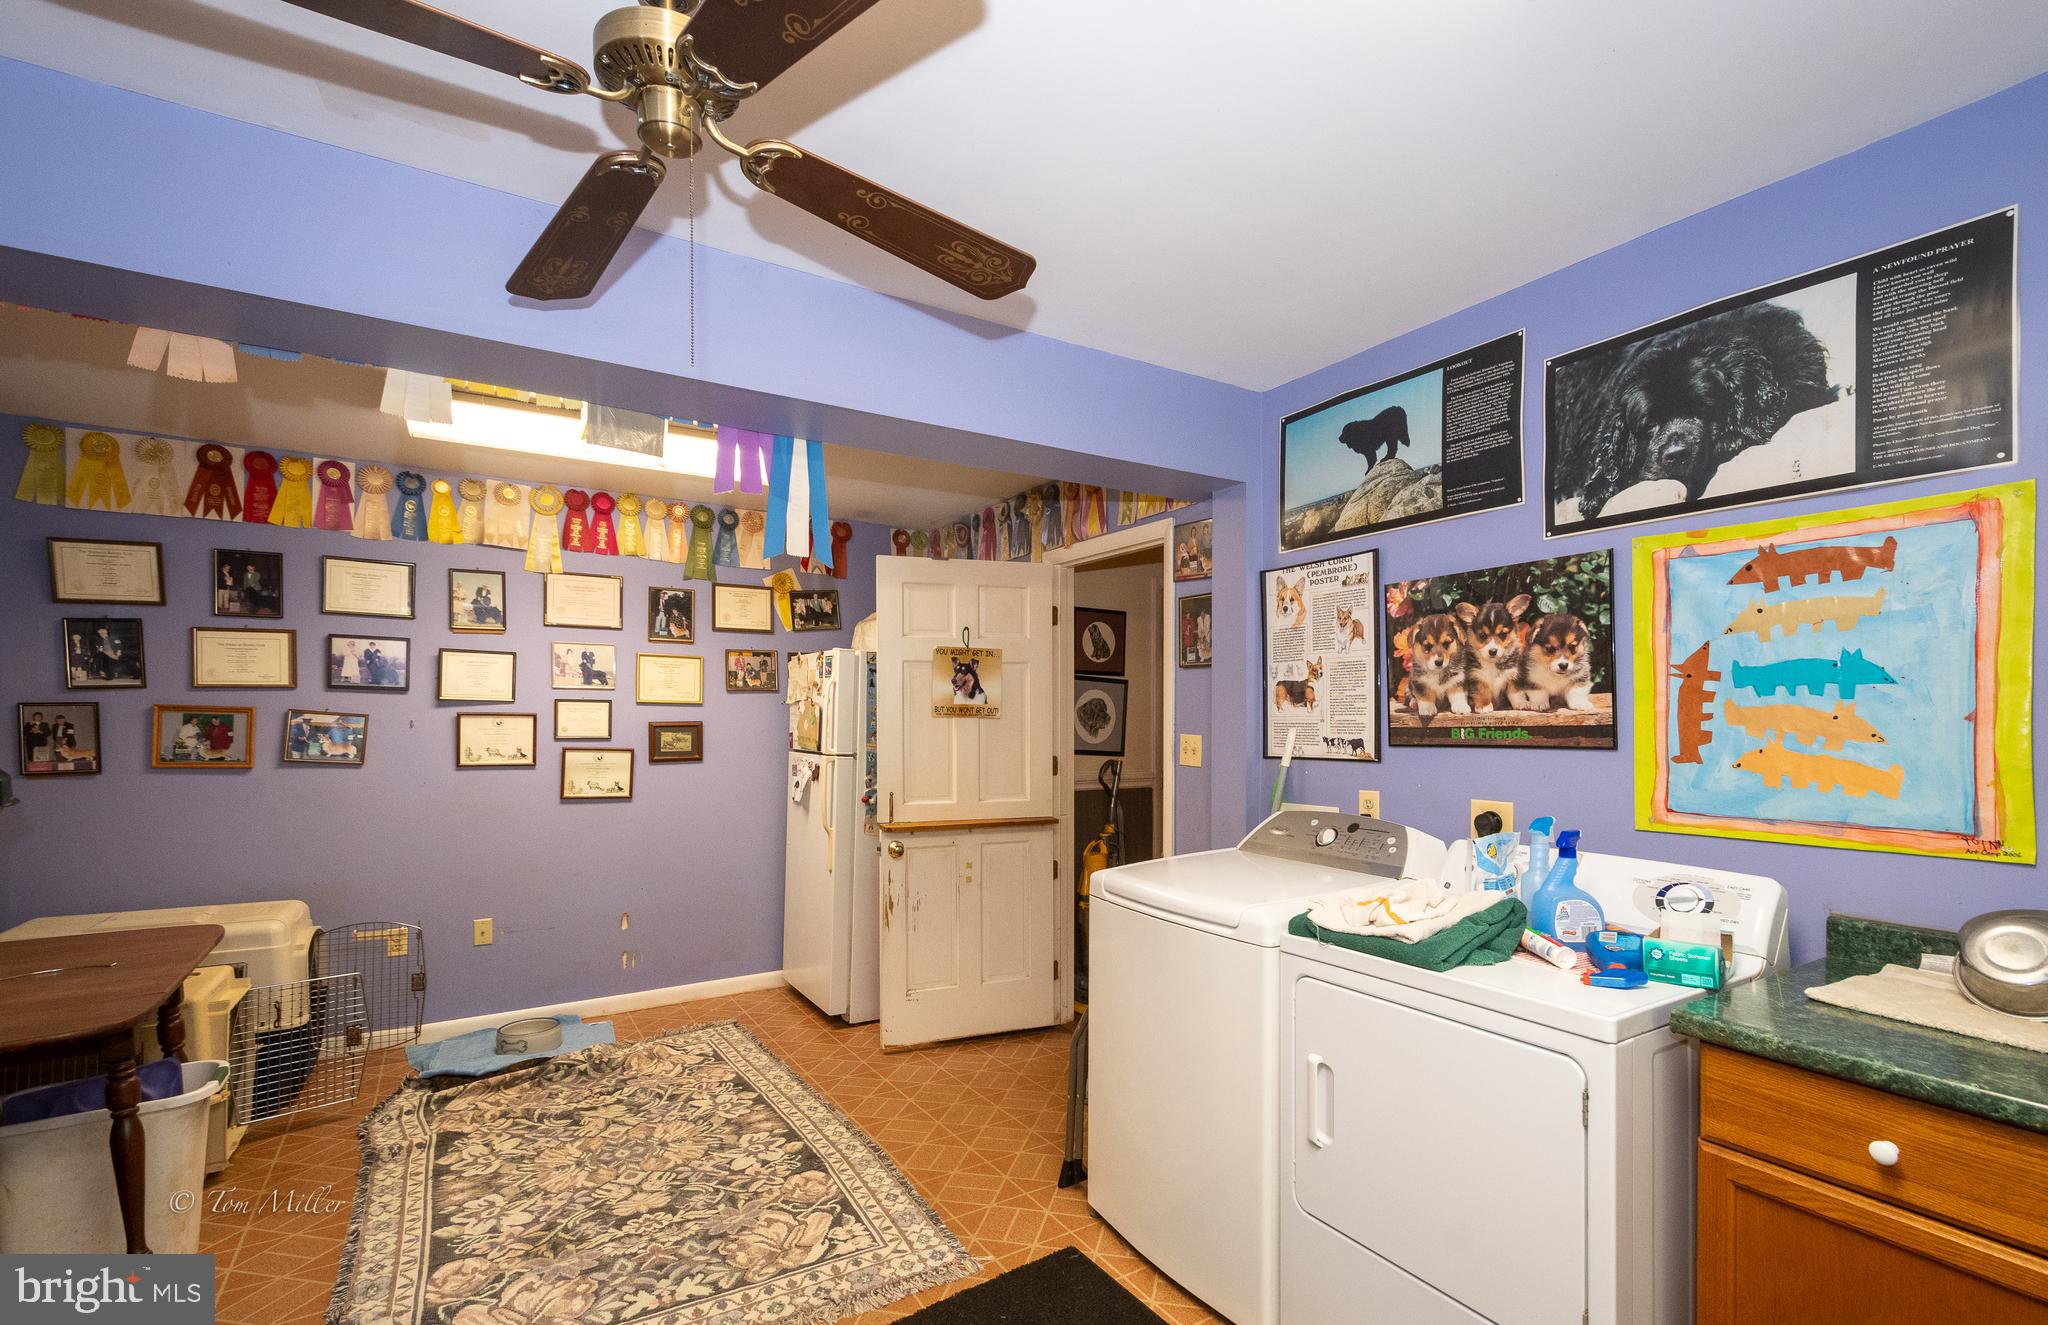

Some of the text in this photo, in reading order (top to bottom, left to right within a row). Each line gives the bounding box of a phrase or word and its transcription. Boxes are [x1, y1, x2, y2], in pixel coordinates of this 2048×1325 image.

[1880, 250, 1933, 270] NEWFOUND
[1935, 237, 1974, 254] PRAYER
[1306, 562, 1358, 578] (PEMBROKE)
[1310, 576, 1340, 586] POSTER
[1451, 728, 1474, 740] BIG
